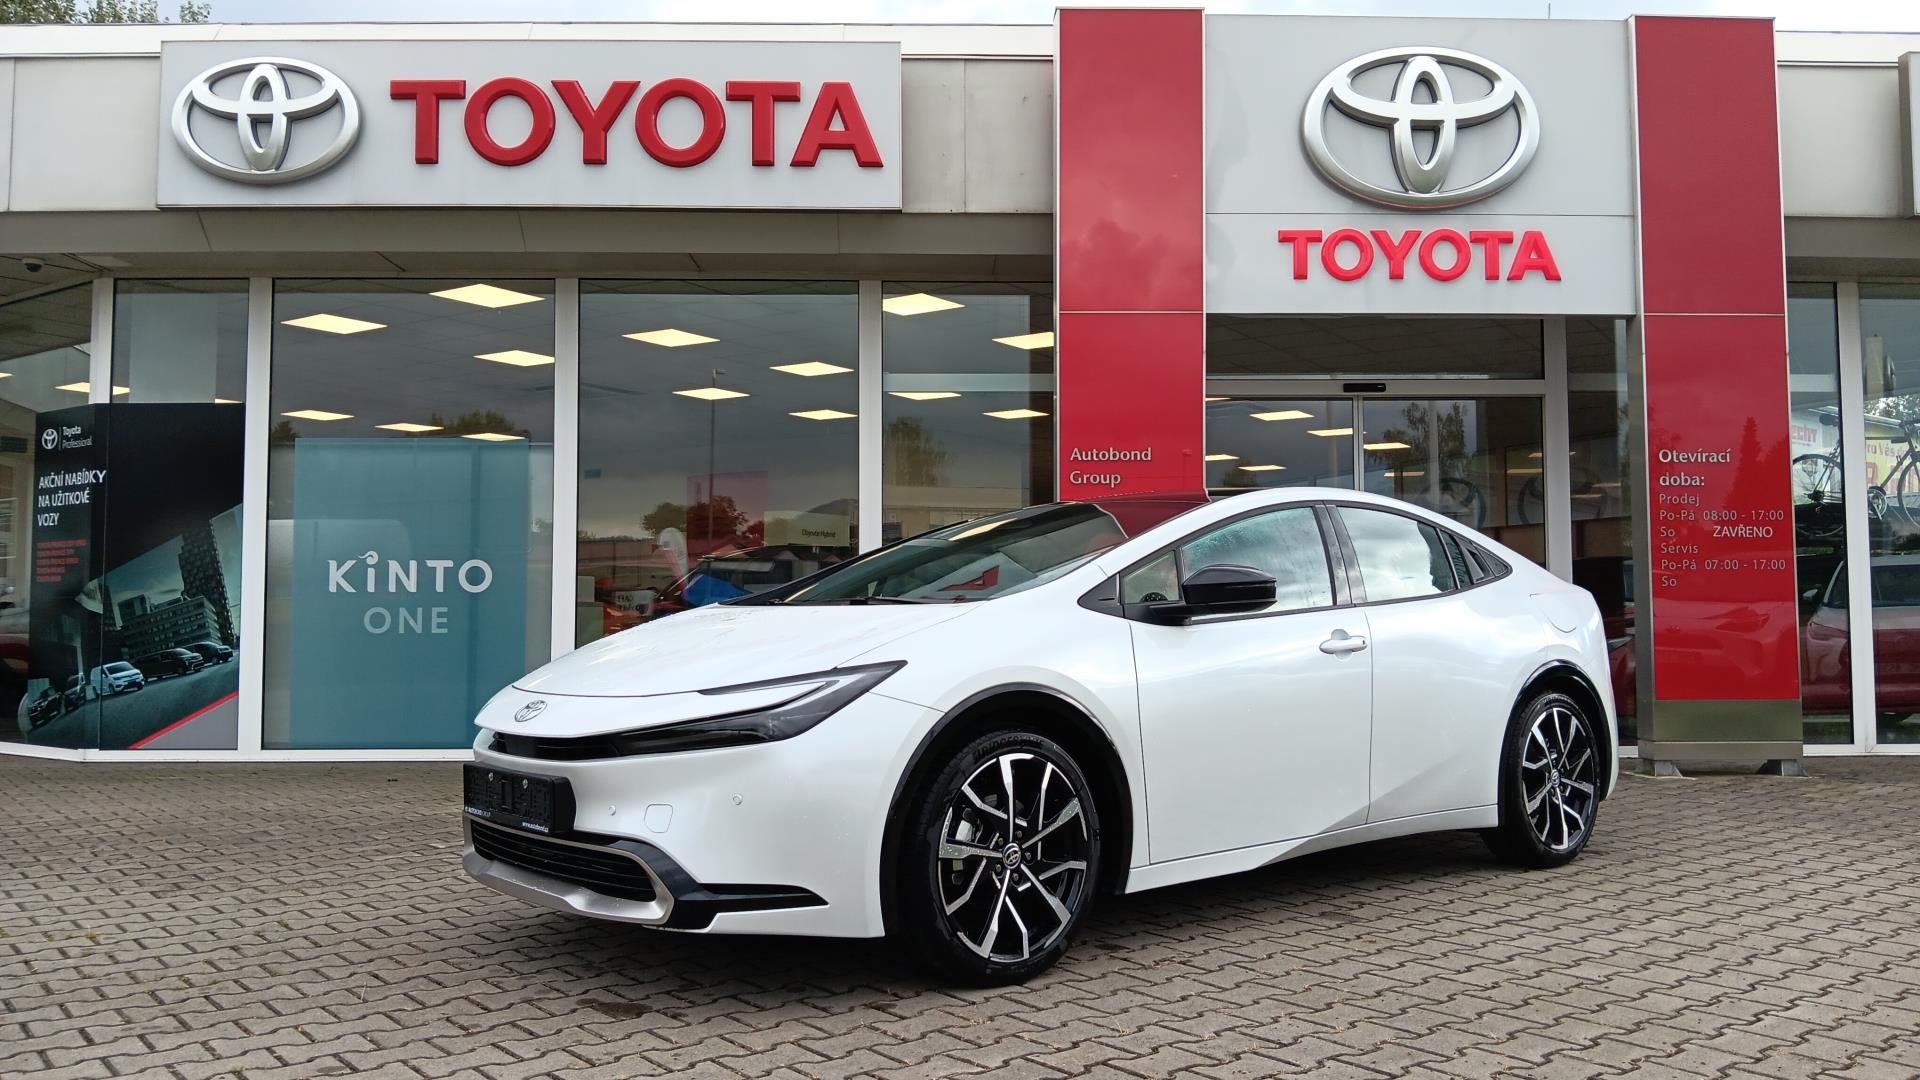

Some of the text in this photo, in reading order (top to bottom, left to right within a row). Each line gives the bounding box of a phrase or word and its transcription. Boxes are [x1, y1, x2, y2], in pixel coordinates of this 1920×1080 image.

[389, 78, 883, 167] TOYOTA
[1277, 227, 1561, 282] TOYOTA
[62, 425, 82, 437] Toyota
[62, 436, 93, 449] Professional
[1070, 447, 1152, 461] Autobond
[1659, 448, 1732, 463] Otevírací
[38, 467, 107, 489] AKČNÍ NABÍDKY
[1069, 470, 1121, 488] Group
[1659, 472, 1705, 486] doba:
[38, 487, 90, 508] NA UŽITKOVÉ
[1659, 493, 1700, 507] Prodej
[37, 512, 60, 527] VOZY
[1659, 510, 1695, 521] Po-Pá
[1703, 510, 1737, 521] 08:00
[1751, 510, 1784, 521] 17:00
[1660, 524, 1773, 538] So ZAVŘENO
[1660, 543, 1698, 554] Servis
[1661, 559, 1697, 570] Po-Pá
[1704, 559, 1739, 570] 07:00
[1753, 559, 1786, 570] 17:00
[1661, 576, 1677, 587] So
[363, 607, 449, 634] ONE
